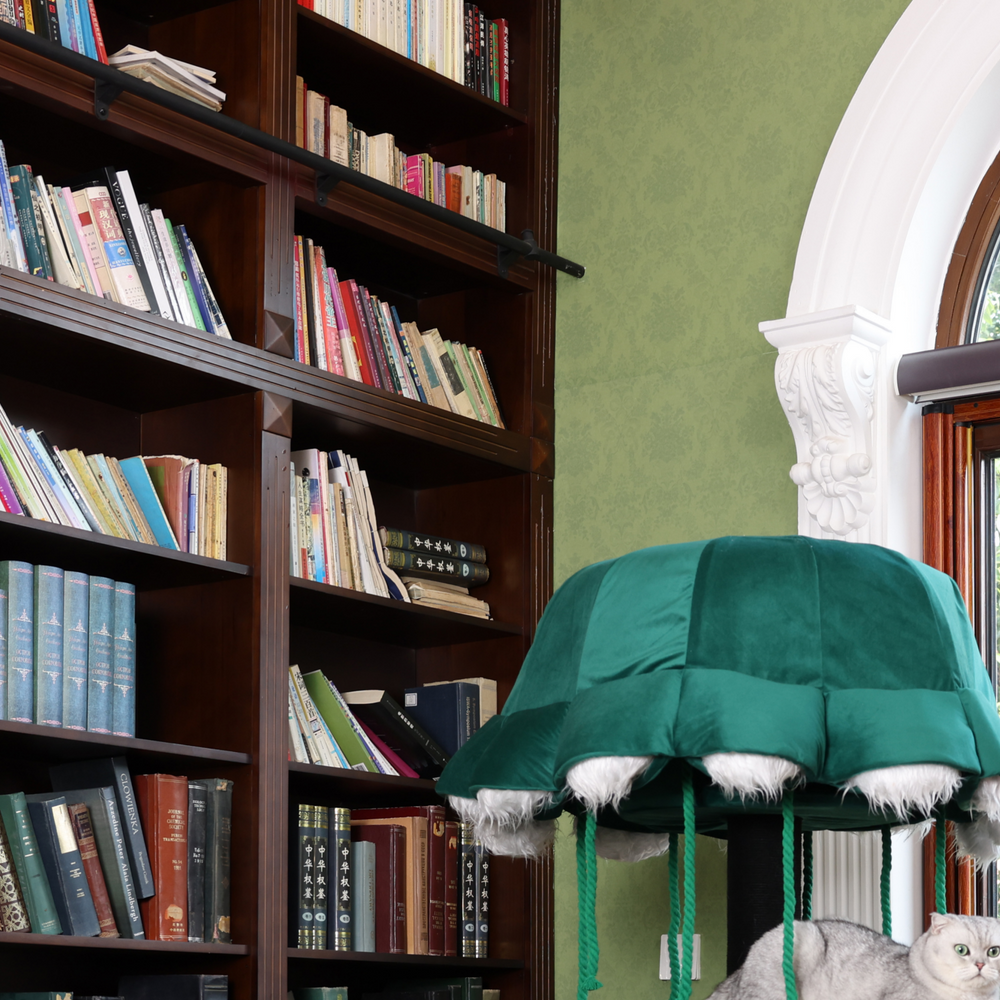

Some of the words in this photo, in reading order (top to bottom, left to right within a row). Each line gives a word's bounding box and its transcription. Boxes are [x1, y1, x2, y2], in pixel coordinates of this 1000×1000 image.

[112, 181, 129, 220] VOGUE
[108, 800, 121, 837] Azzedine
[116, 839, 125, 860] Peter
[125, 883, 139, 922] Lindbergh
